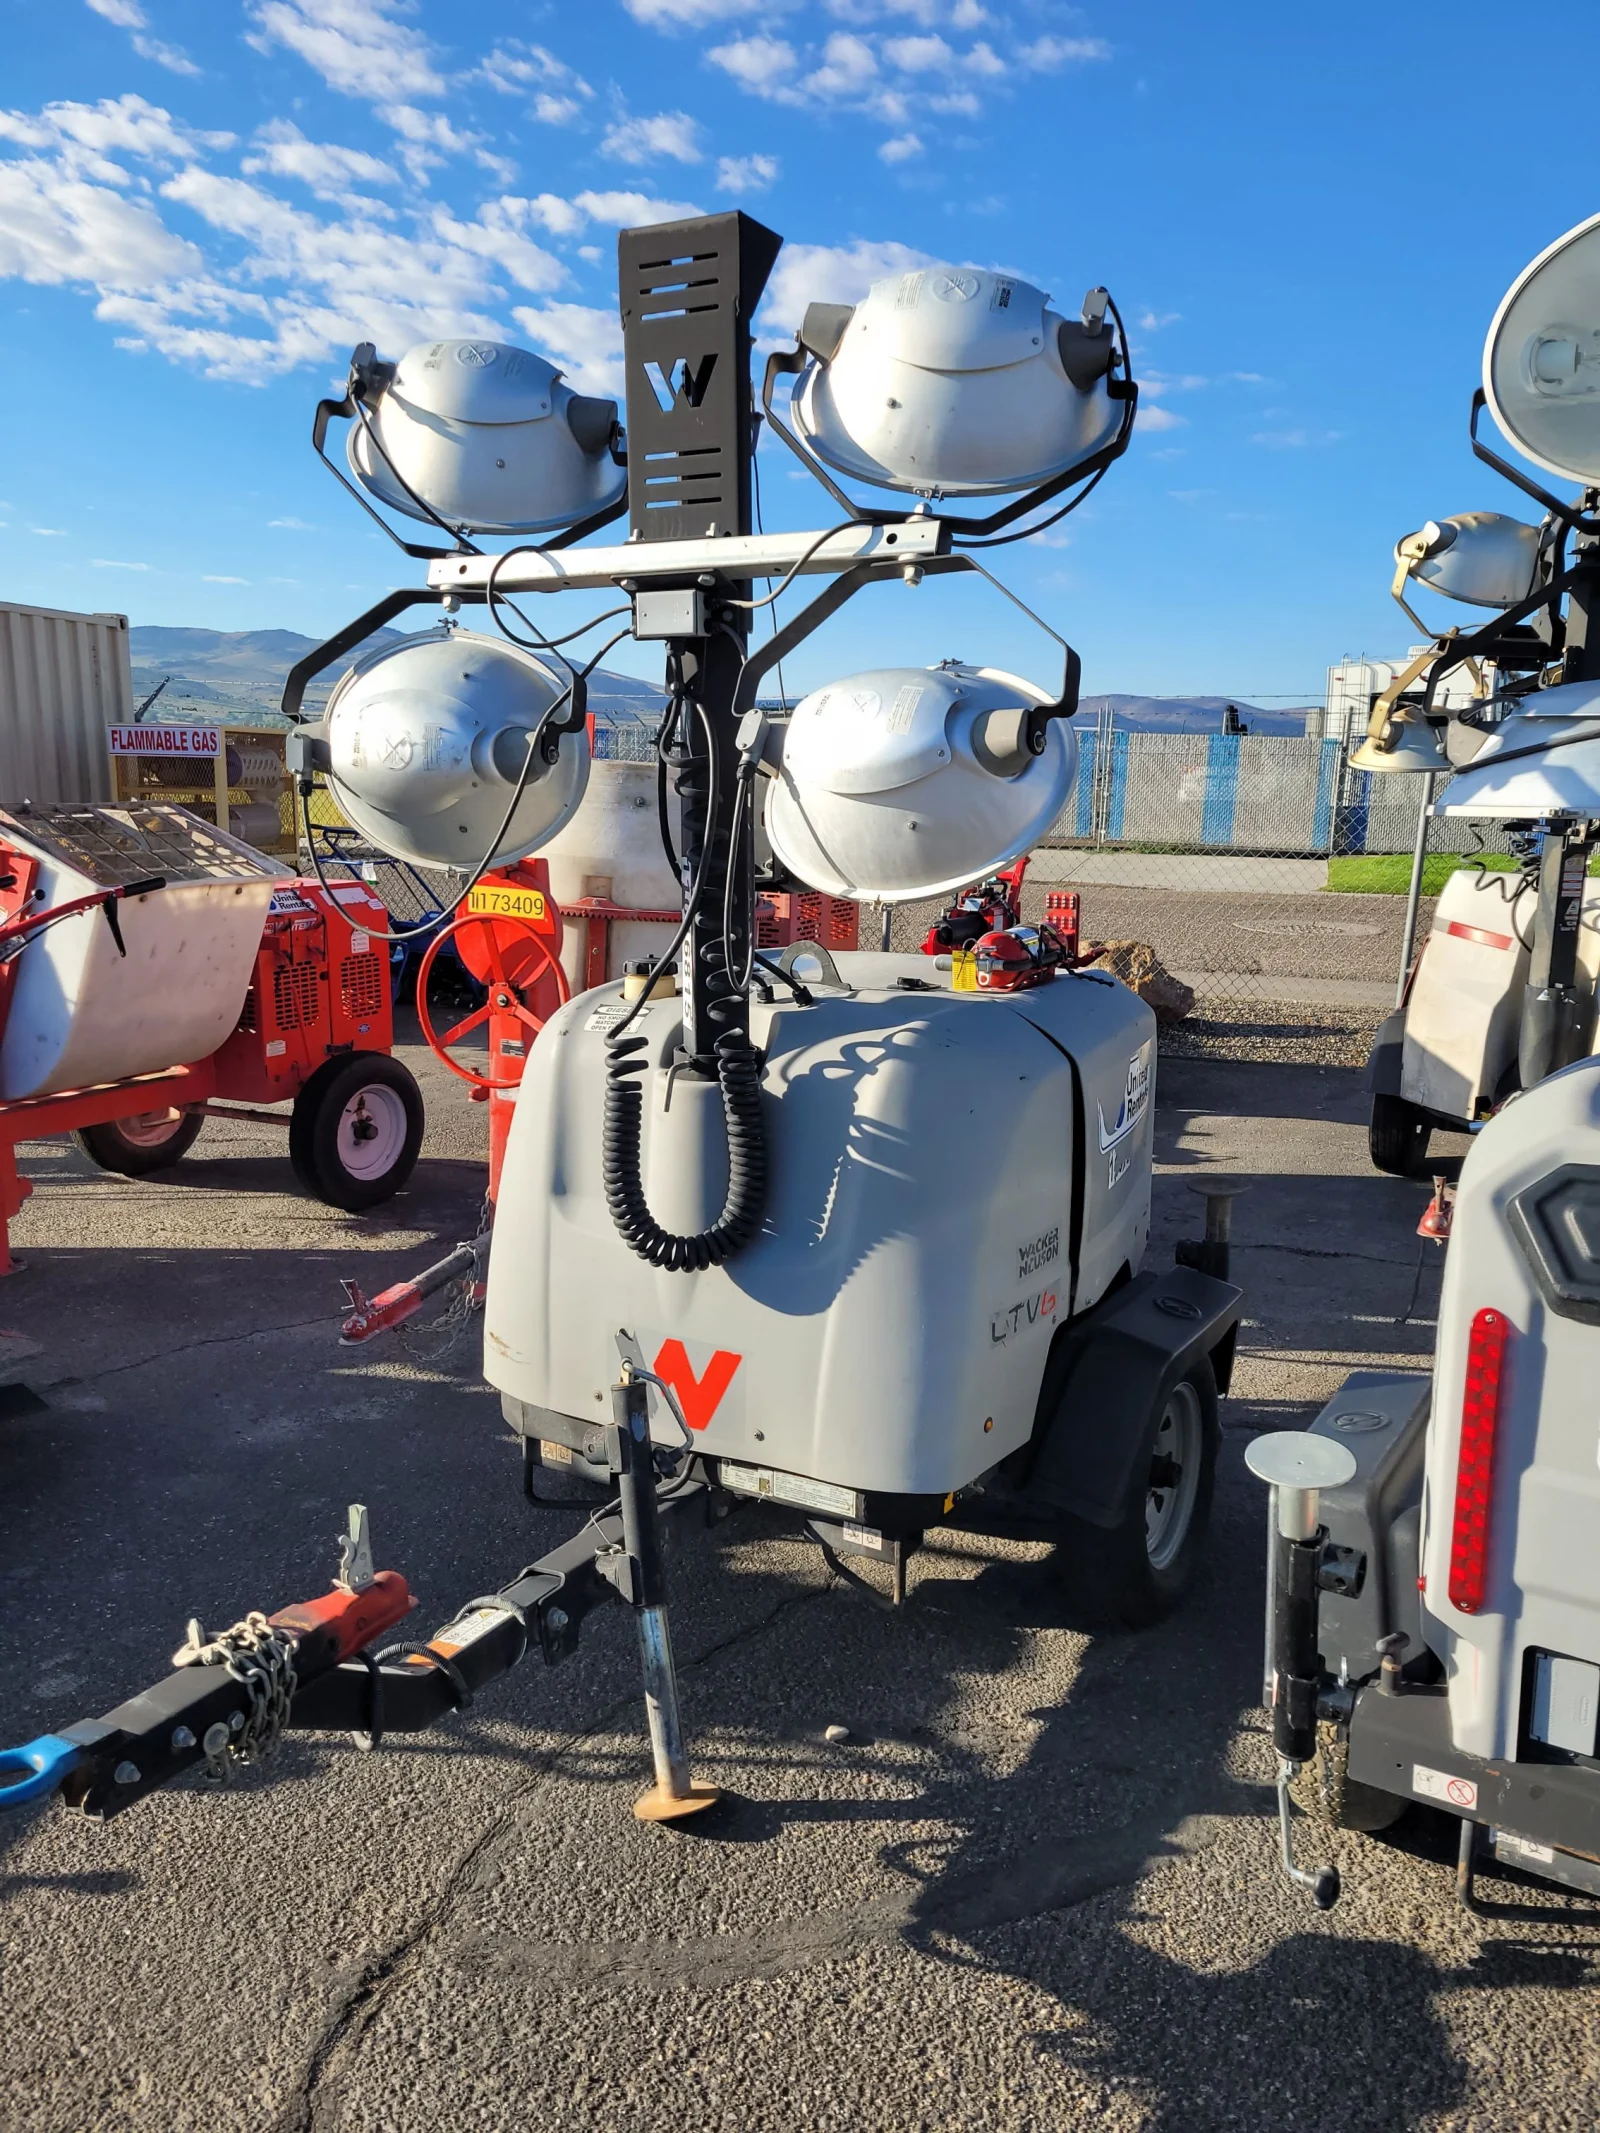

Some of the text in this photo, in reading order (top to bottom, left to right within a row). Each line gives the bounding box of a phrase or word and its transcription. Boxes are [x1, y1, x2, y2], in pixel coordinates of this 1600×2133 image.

[111, 730, 218, 752] FLAMMABLE GAS
[273, 893, 300, 902] Unite
[1019, 1227, 1059, 1261] WACKER
[1019, 1241, 1059, 1278] NEUSON
